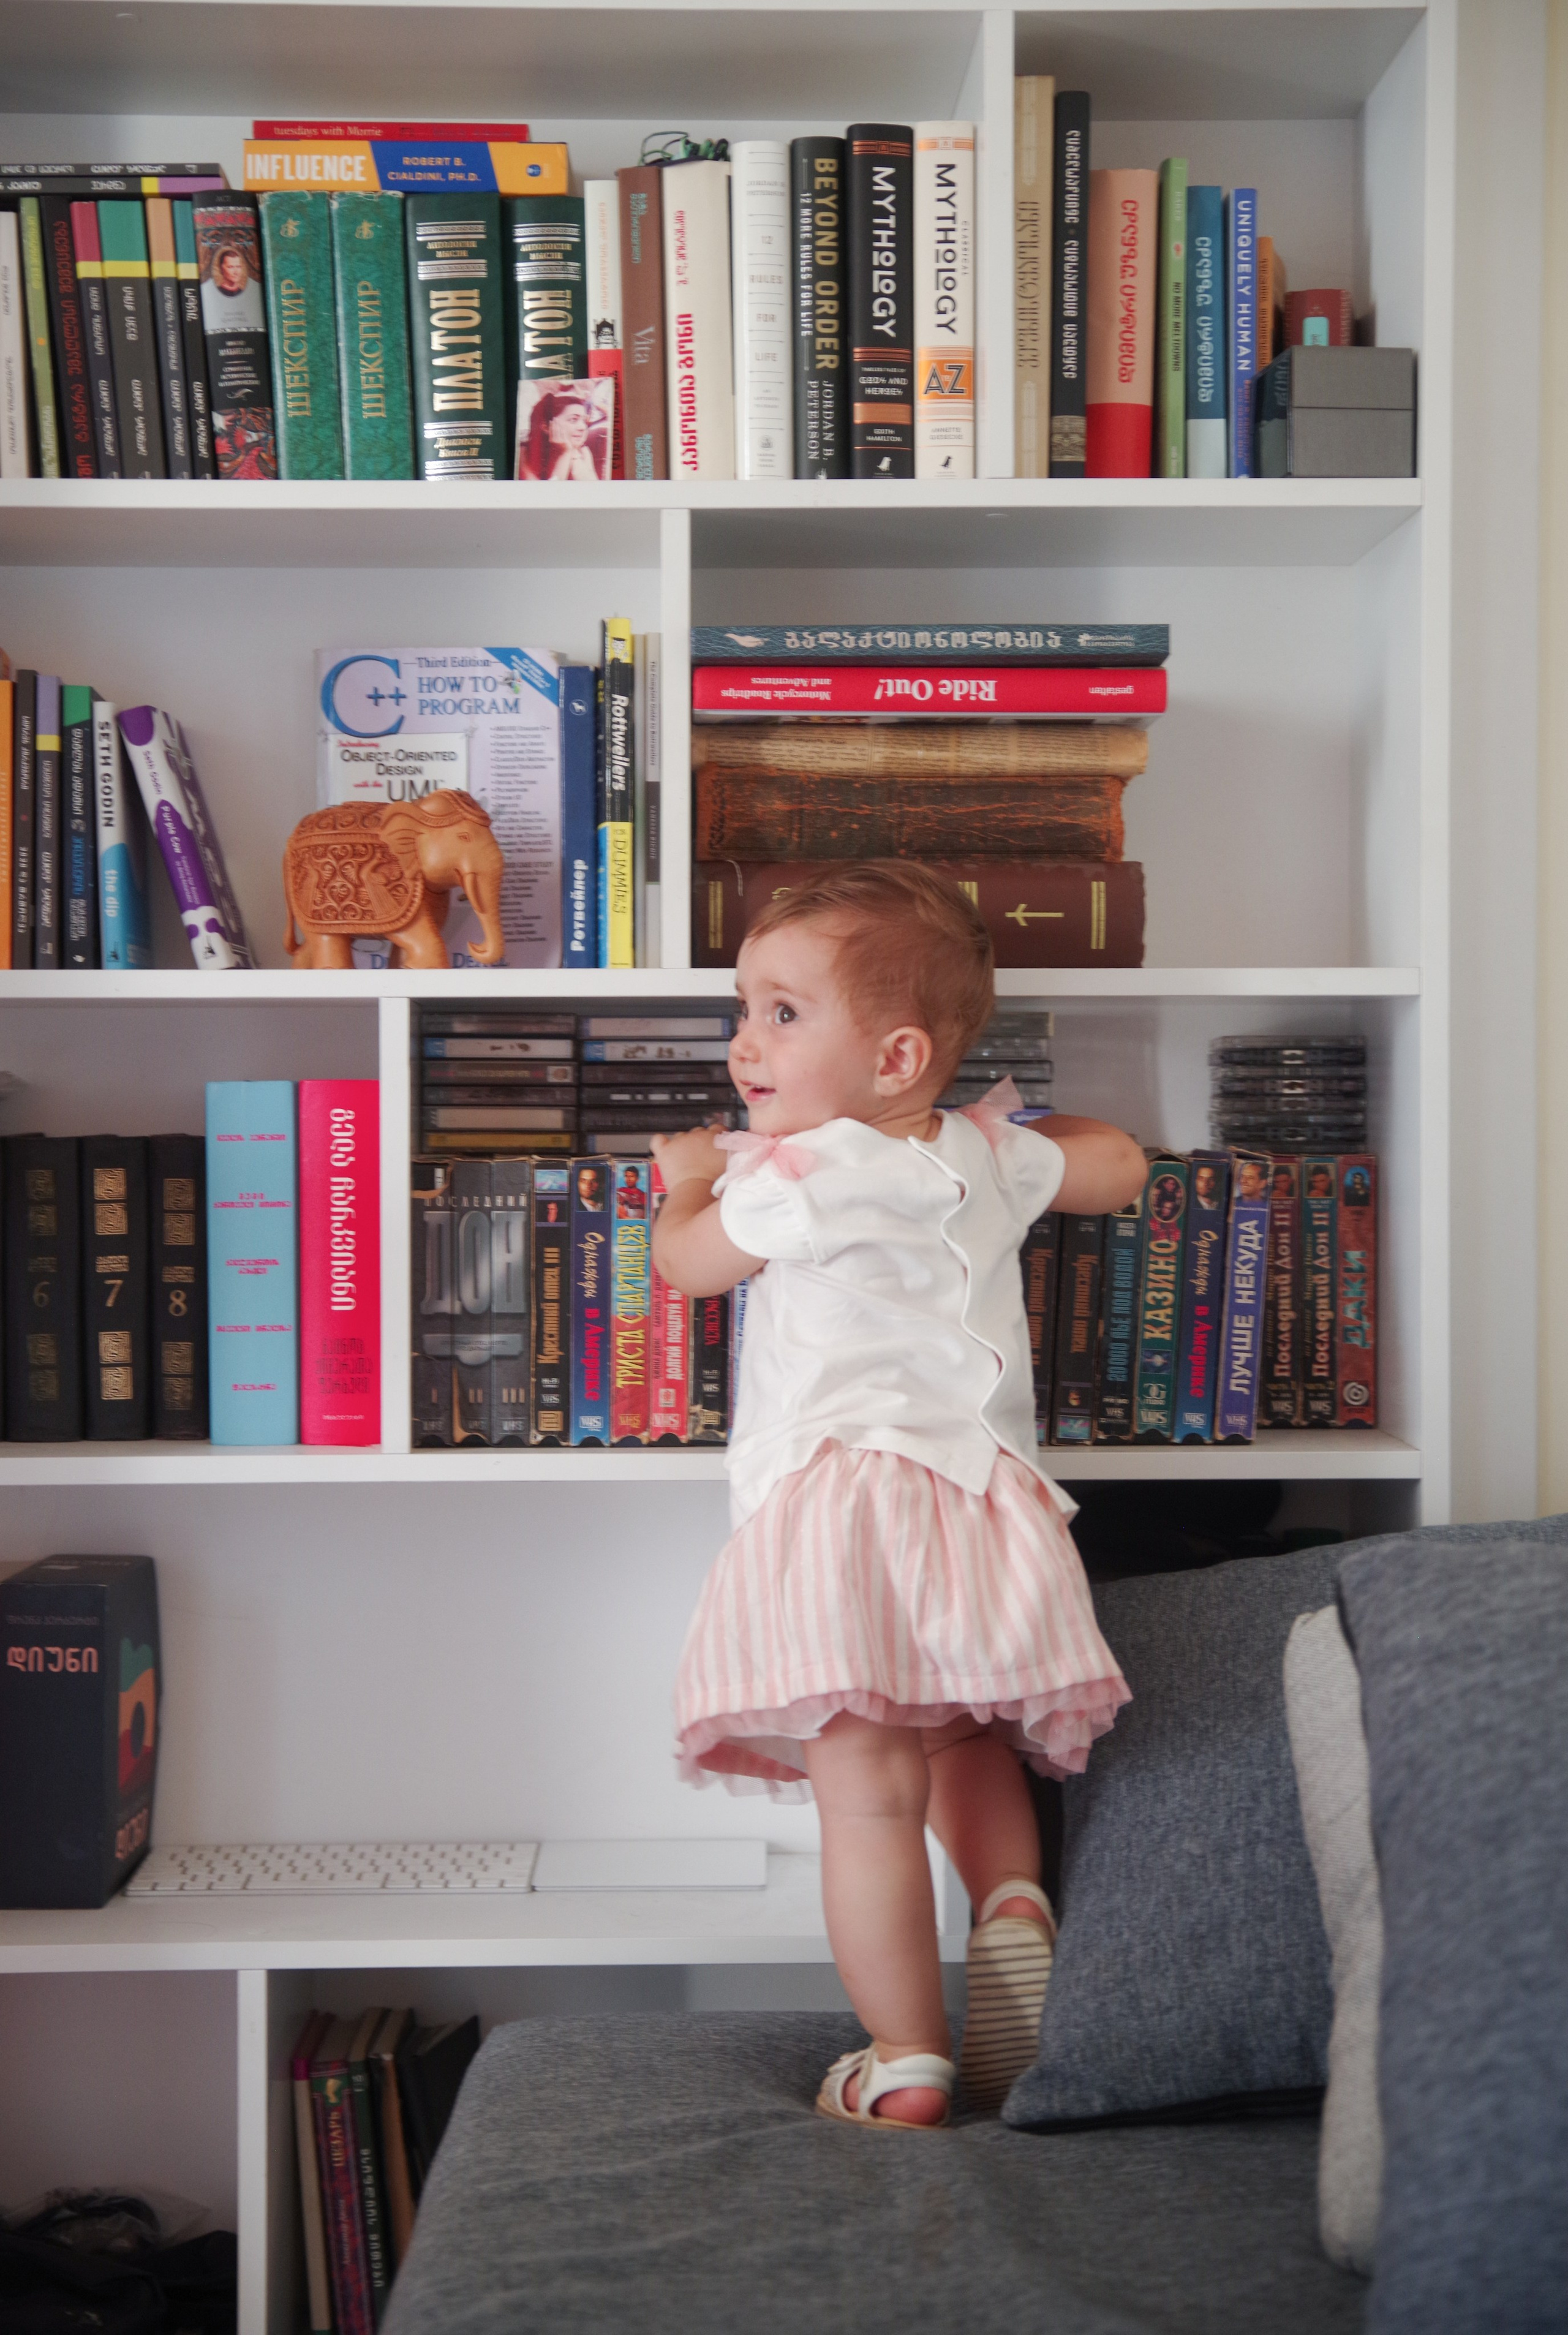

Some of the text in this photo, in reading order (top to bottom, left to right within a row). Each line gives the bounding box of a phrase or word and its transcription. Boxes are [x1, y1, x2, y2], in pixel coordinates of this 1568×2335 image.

[321, 125, 343, 136] with
[246, 154, 366, 181] INFLUENCE
[386, 171, 446, 182] CIALDINI,
[402, 156, 467, 166] ROBERT B.
[799, 192, 813, 336] 12 MORE RULES FOR LIFE
[813, 158, 840, 369] BEYOND ORDER
[872, 165, 897, 338] MYTHOLOGY
[935, 164, 959, 335] MYTHOLOGY
[1062, 130, 1081, 379] ქართული მითოლოგია ენციკლოპედია
[748, 274, 785, 285] RULES
[1015, 201, 1041, 368] ვეფხისტყაოსანი
[1118, 199, 1139, 383] დიმიტრი უზნაძე
[1237, 200, 1252, 371] UNIQUELY HUMAN
[756, 314, 778, 323] FOR
[1171, 282, 1183, 371] NO MORE MELTDOWNS
[1194, 236, 1215, 402] დიმიტრი უზნაძე
[276, 278, 307, 418] ШЕКСПИР
[355, 280, 387, 420] ШЕКСПИР
[429, 288, 484, 412] ПЛАТОН
[633, 325, 657, 366] Vita
[755, 352, 779, 362] LIFE
[675, 313, 698, 471] კანონთა გონი
[821, 380, 835, 442] JORDAN
[807, 380, 820, 460] PETERSON
[785, 630, 1063, 649] გალაკტიონოლოგია
[416, 657, 491, 668] Third Edition
[750, 677, 832, 687] and Adventures
[320, 654, 407, 738] C++
[417, 676, 497, 693] HOW TO
[648, 674, 657, 702] Complete
[773, 688, 832, 701] Motorcycle
[873, 678, 998, 703] Ride Out!
[418, 698, 521, 715] PROGRAM
[611, 694, 630, 791] Rottweilers
[98, 721, 115, 828] SETH GODIN
[142, 750, 164, 796] Seth Godin
[376, 763, 424, 775] DESIGN
[160, 805, 183, 854] Purple Cow
[104, 869, 119, 918] the dip
[611, 840, 628, 913] DUMMIES
[570, 859, 589, 951] Ротвейлер
[329, 1107, 356, 1311] გელა ჩარკვიანი
[424, 1193, 528, 1207] ПОСЛЕДНИЙ
[1313, 1212, 1330, 1226] II
[420, 1211, 527, 1315] ДОН
[1111, 1248, 1135, 1288] ВОДОЙ
[1312, 1232, 1332, 1269] Дон
[33, 1281, 51, 1307] 6
[103, 1279, 124, 1307] 7
[168, 1289, 188, 1317] 8
[537, 1247, 565, 1364] Крестный отец III
[616, 1224, 650, 1388] ТРИСТА СПАРТАНЦЕВ
[1069, 1254, 1099, 1353] Крестный отец
[1111, 1291, 1133, 1314] ПОД
[1143, 1239, 1178, 1341] КАЗИНО
[1229, 1220, 1262, 1395] ЛУЧШЕ НЕКУДА
[1273, 1213, 1297, 1377] Последний Дон II
[1343, 1250, 1371, 1349] ДАКИ
[576, 1231, 606, 1401] Однажды в Америке
[665, 1303, 685, 1343] ПОЦЕЛУЙ
[704, 1300, 720, 1346] РАССВЕТА
[1109, 1317, 1132, 1339] ЛЬЕ
[1188, 1230, 1219, 1398] Однажды в Америке
[1312, 1273, 1334, 1377] Последний
[663, 1346, 684, 1380] ДОЛГИЙ
[469, 1387, 483, 1404] II
[502, 1387, 526, 1404] III
[541, 1394, 561, 1403] VHS
[579, 1416, 603, 1428] VHS
[619, 1414, 642, 1425] VHS
[654, 1414, 680, 1427] VHS
[1141, 1410, 1168, 1424] VHS
[1184, 1413, 1205, 1424] VHS
[1226, 1414, 1248, 1426] VHS
[6, 1645, 99, 1673] დიუნი
